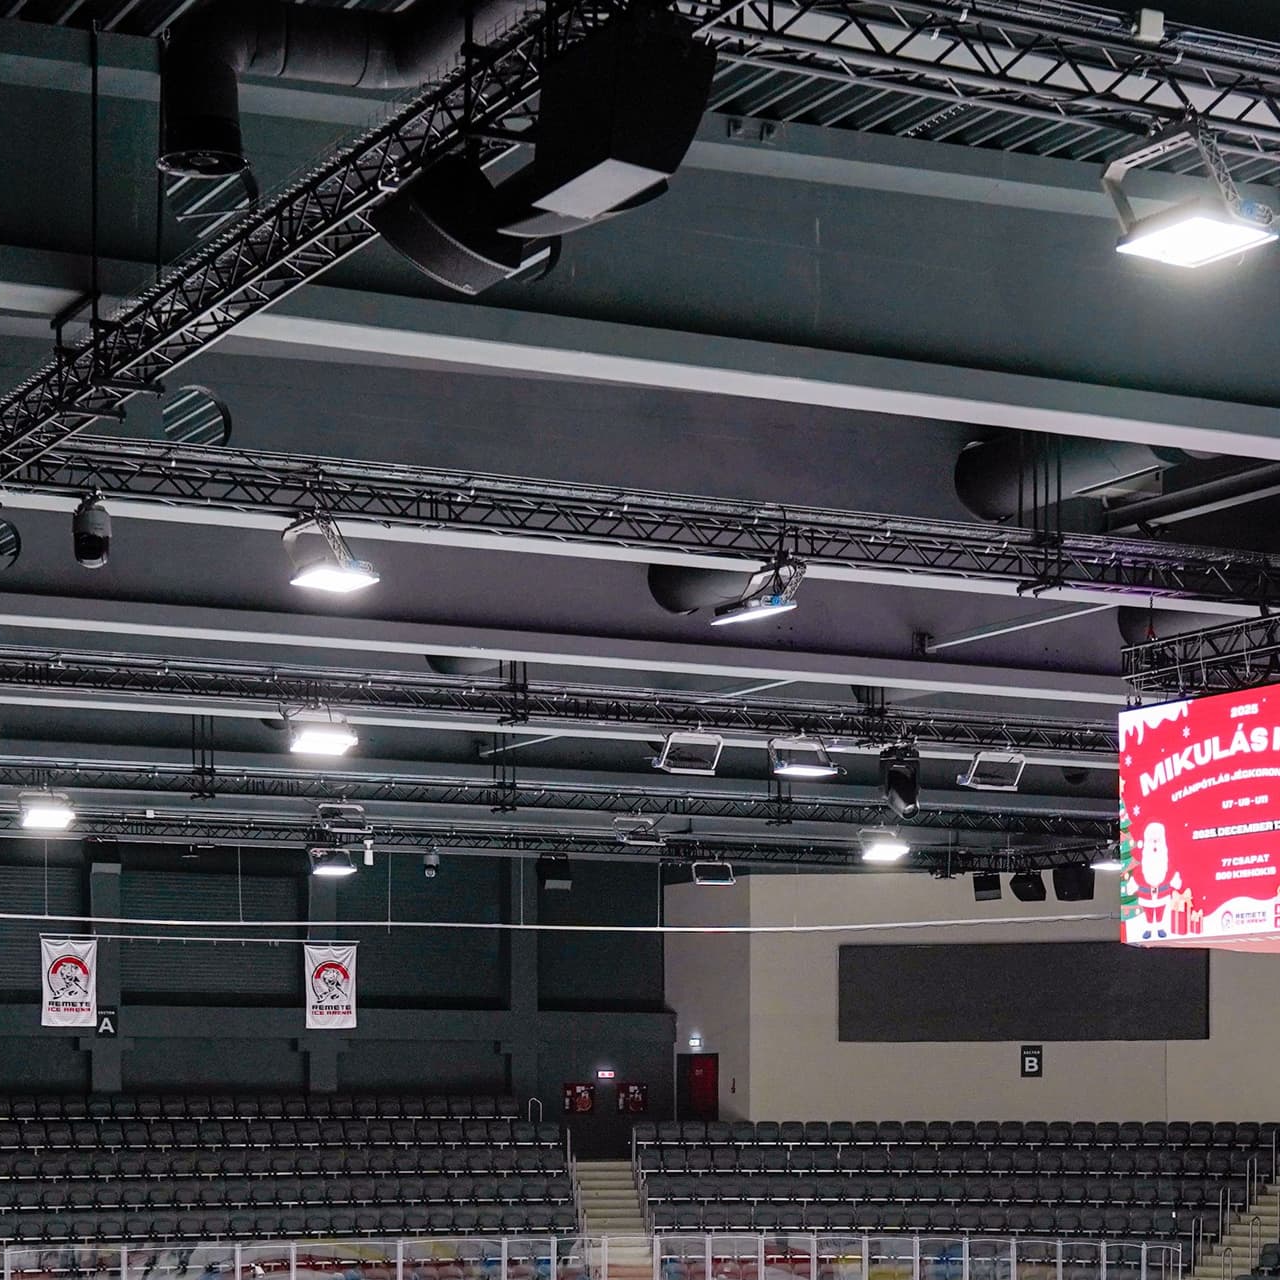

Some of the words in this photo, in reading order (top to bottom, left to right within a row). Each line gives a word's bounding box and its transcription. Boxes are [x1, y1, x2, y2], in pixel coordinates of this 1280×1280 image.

[1230, 703, 1259, 718] 2025
[1139, 723, 1269, 797] MIKULÁS
[1218, 821, 1273, 837] DECEMBER
[1233, 854, 1270, 866] CSAPAT
[98, 1017, 114, 1033] A
[1025, 1057, 1039, 1072] B
